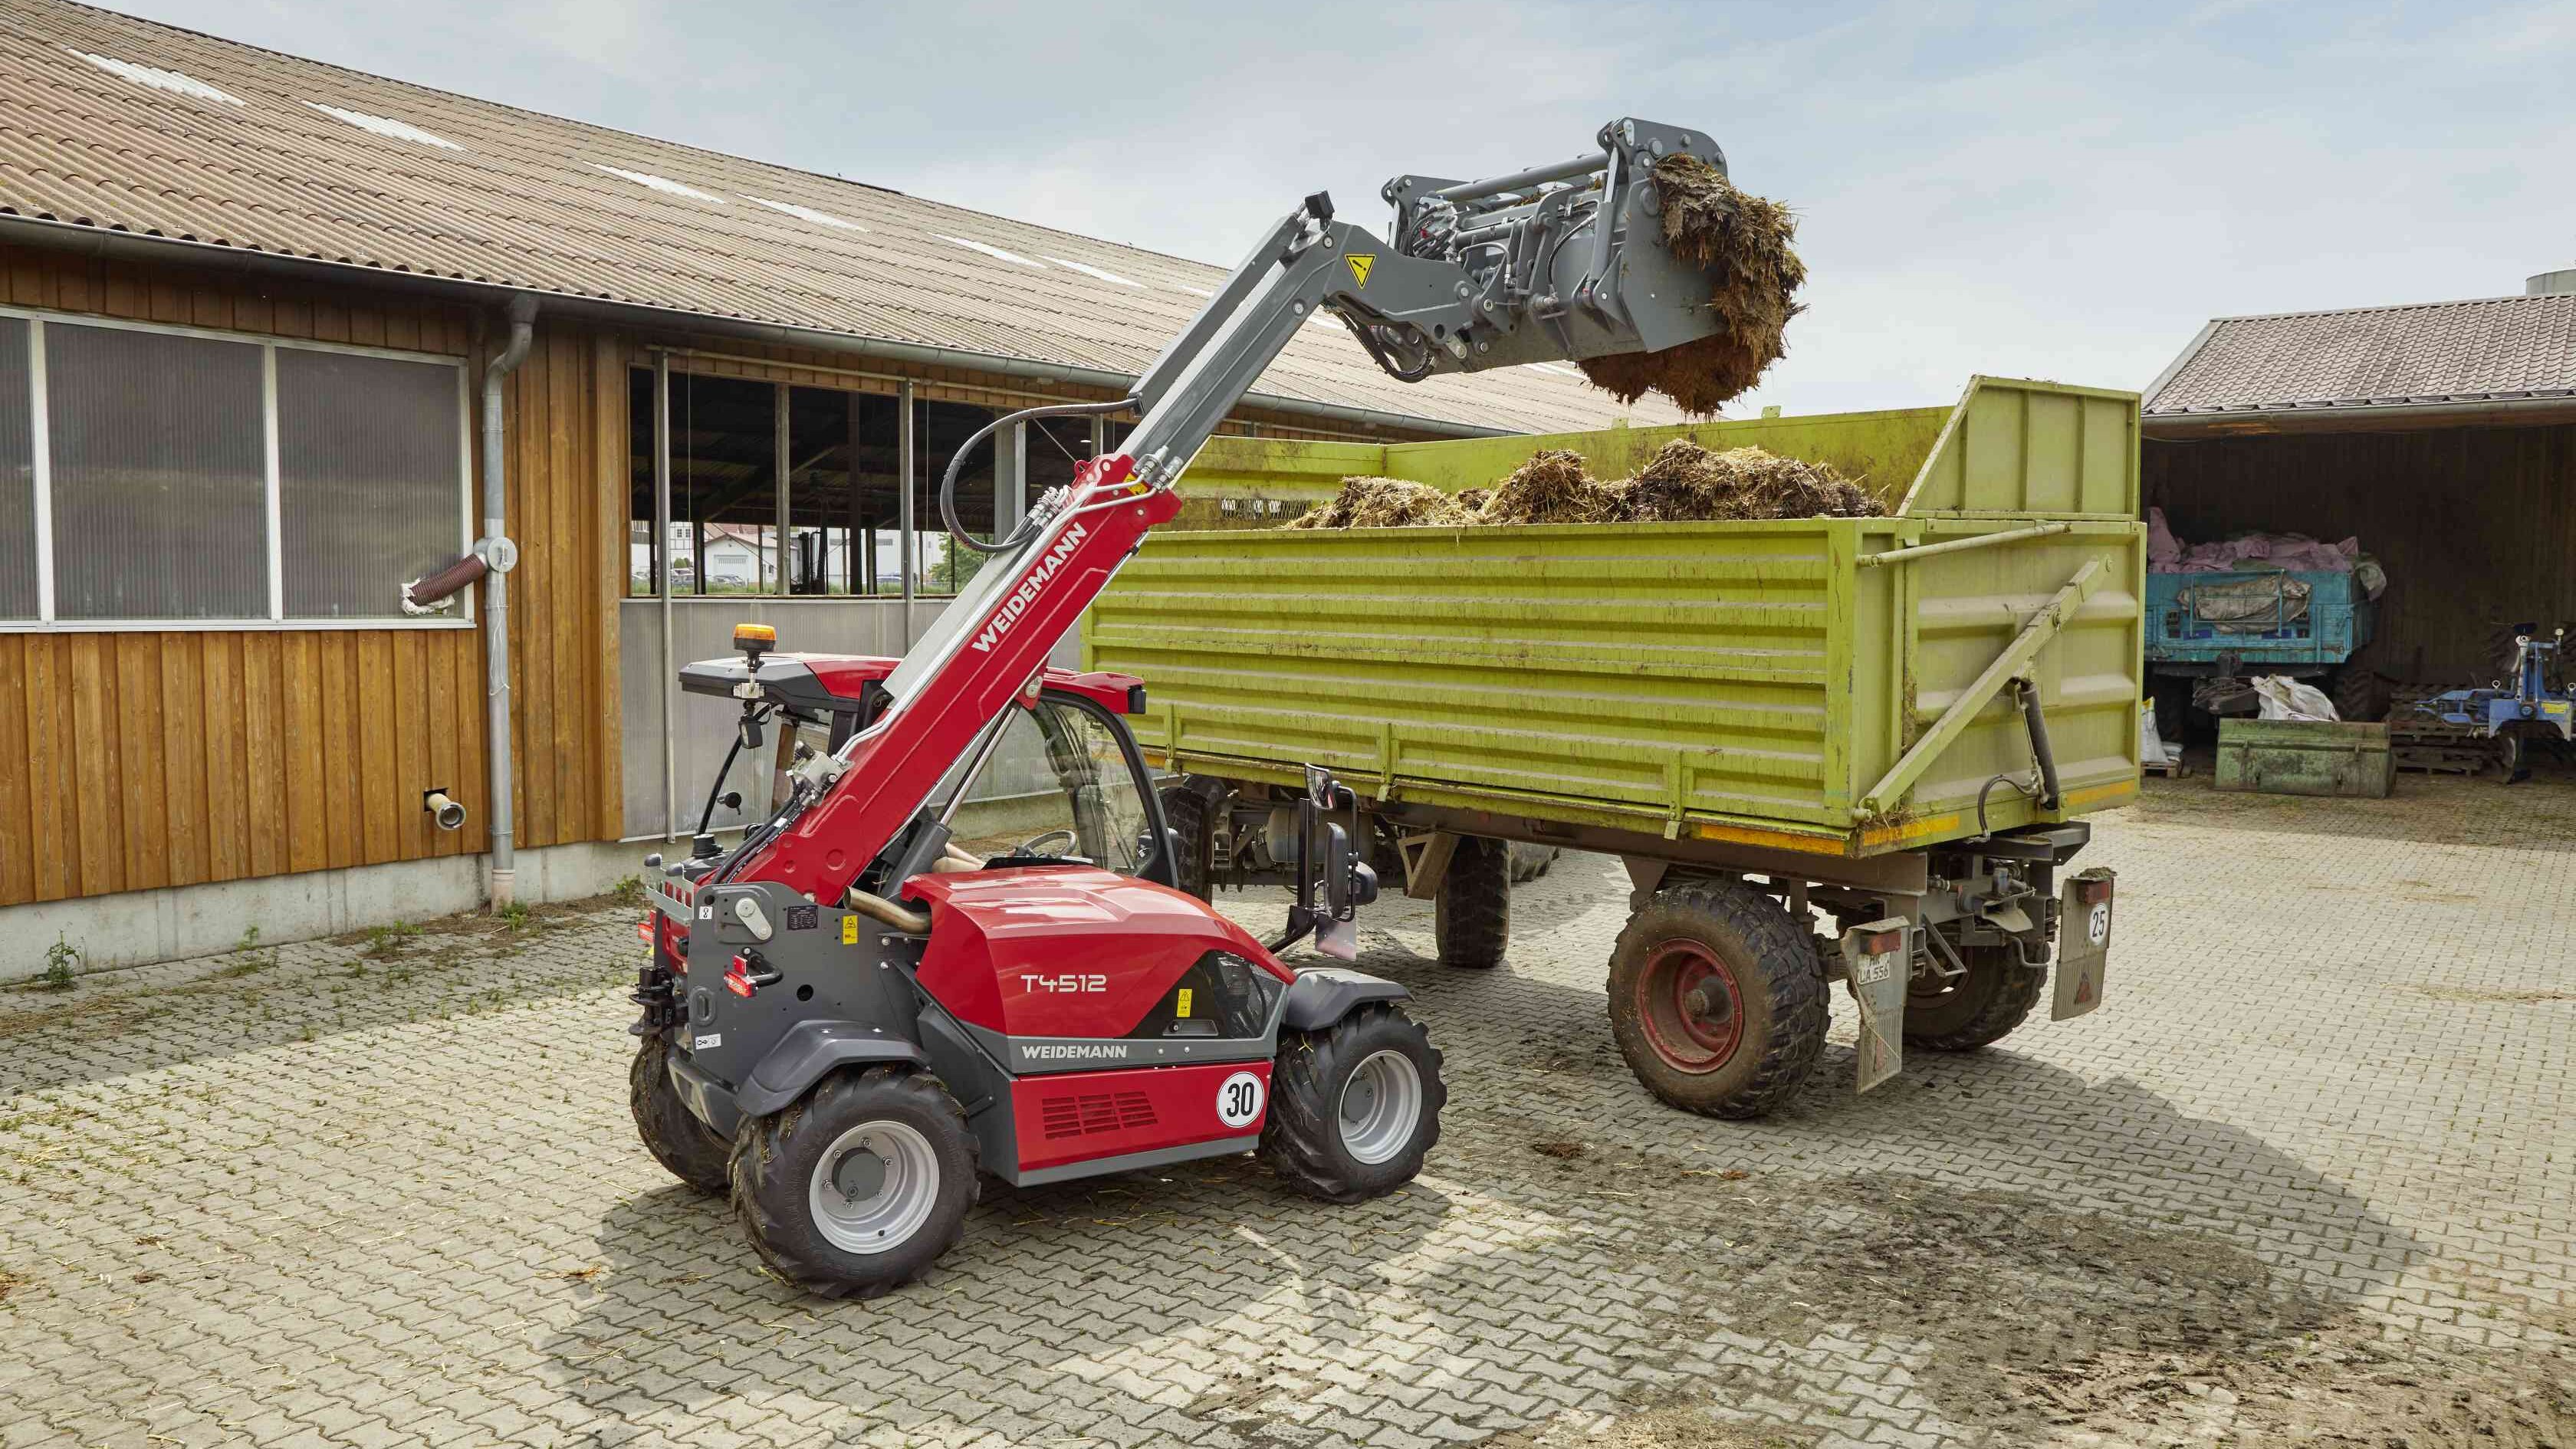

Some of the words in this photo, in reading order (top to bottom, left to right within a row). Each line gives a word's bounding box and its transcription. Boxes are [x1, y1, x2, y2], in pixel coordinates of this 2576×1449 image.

[971, 521, 1087, 652] WEIDEMANN
[2092, 910, 2105, 937] 25
[1020, 974, 1107, 992] T4512
[1022, 1045, 1127, 1059] WEIDEMANN
[1227, 1082, 1254, 1117] 30
